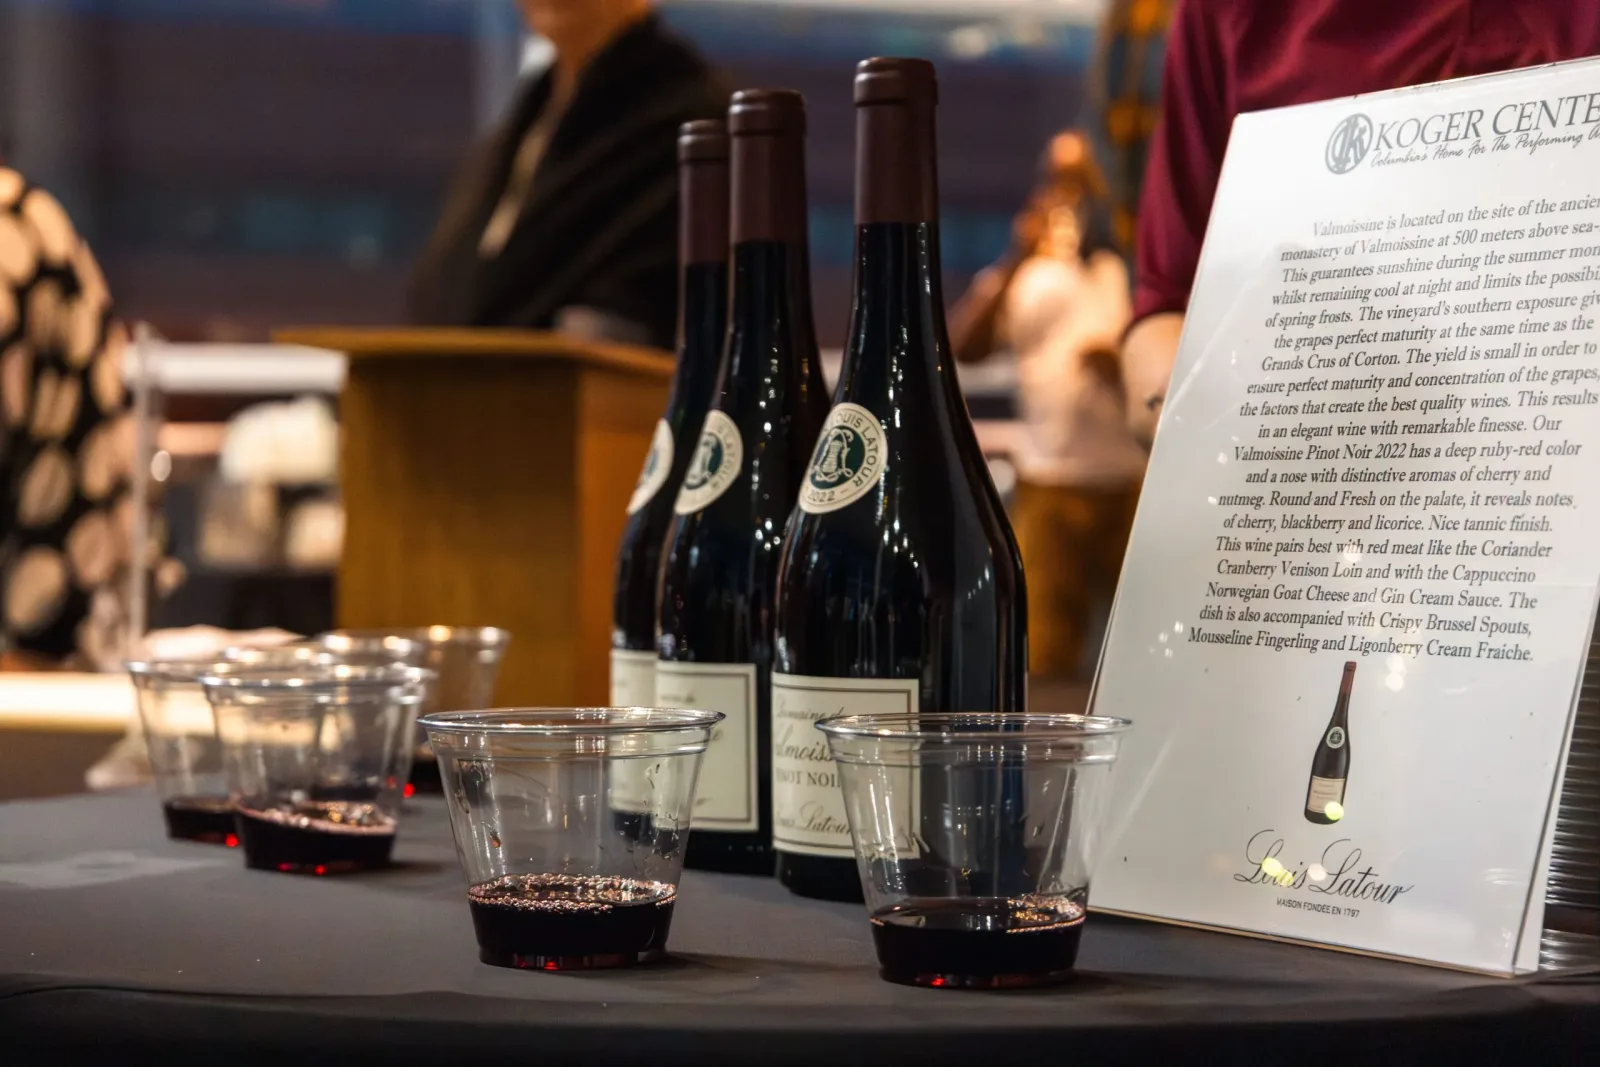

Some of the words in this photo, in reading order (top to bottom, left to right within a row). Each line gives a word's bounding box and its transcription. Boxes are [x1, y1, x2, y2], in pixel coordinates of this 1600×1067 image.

[1373, 108, 1484, 151] KOGER
[1371, 146, 1428, 168] Columbia's
[1433, 144, 1465, 160] Home
[1468, 140, 1486, 158] For
[1491, 136, 1510, 152] The
[1515, 132, 1583, 155] Performing
[1313, 220, 1383, 236] Valmoissine
[1399, 210, 1445, 228] located
[1492, 204, 1514, 218] site
[1280, 246, 1342, 261] monastery
[1360, 235, 1434, 253] Valmoissine
[1453, 229, 1478, 245] 500
[1480, 228, 1525, 243] meters
[1528, 222, 1568, 238] above
[1282, 268, 1308, 283] This
[1309, 266, 1374, 284] guarantees
[1377, 258, 1432, 274] sunshine
[1436, 254, 1481, 271] during
[1508, 248, 1566, 263] summer
[1272, 289, 1307, 305] whilst
[1309, 285, 1371, 302] remaining
[1374, 282, 1401, 297] cool
[1418, 277, 1451, 297] night
[1455, 275, 1481, 291] and
[1483, 273, 1522, 289] limits
[1279, 311, 1316, 330] spring
[1318, 309, 1353, 324] frosts.
[1359, 306, 1383, 321] The
[1453, 297, 1511, 315] southern
[1516, 295, 1578, 314] exposure
[1274, 334, 1292, 348] the
[1294, 335, 1333, 350] grapes
[1335, 329, 1379, 349] perfect
[1381, 325, 1437, 343] maturity
[1455, 322, 1477, 338] the
[1480, 323, 1514, 336] same
[1518, 319, 1550, 334] time
[1572, 315, 1594, 330] the
[1262, 355, 1304, 371] Grands
[1307, 354, 1336, 368] Crus
[1355, 351, 1400, 366] Corton.
[1406, 348, 1432, 364] The
[1433, 346, 1468, 366] yield
[1484, 342, 1521, 360] small
[1541, 341, 1579, 356] order
[1247, 383, 1285, 394] ensure
[1286, 377, 1329, 396] perfect
[1331, 374, 1385, 392] maturity
[1388, 372, 1413, 387] and
[1415, 369, 1505, 387] concentration
[1526, 367, 1548, 382] the
[1240, 402, 1258, 416] the
[1260, 401, 1299, 415] factors
[1302, 400, 1326, 414] that
[1328, 400, 1364, 413] create
[1368, 398, 1388, 412] the
[1391, 397, 1417, 411] best
[1420, 394, 1466, 414] quality
[1470, 394, 1511, 408] wines.
[1518, 390, 1548, 407] This
[1552, 389, 1599, 405] results
[1291, 423, 1333, 441] elegant
[1337, 422, 1366, 436] wine
[1370, 420, 1398, 435] with
[1401, 417, 1475, 434] remarkable
[1478, 416, 1527, 433] finesse.
[1532, 414, 1562, 431] Our
[833, 412, 863, 429] OUIS
[852, 426, 878, 488] LATOUR
[1234, 446, 1303, 461] Valmoissine
[1306, 444, 1340, 460] Pinot
[1343, 444, 1372, 459] Noir
[1375, 443, 1407, 459] 2022
[1409, 443, 1430, 458] has
[1445, 442, 1477, 461] deep
[1480, 440, 1543, 460] ruby-red
[1545, 440, 1582, 456] color
[1246, 468, 1269, 483] and
[1280, 472, 1307, 482] nose
[1311, 468, 1337, 482] with
[1341, 467, 1406, 482] distinctive
[1409, 469, 1456, 482] aromas
[1476, 466, 1520, 485] cherry
[1524, 465, 1552, 481] and
[1218, 494, 1265, 510] nutmeg.
[1269, 491, 1312, 506] Round
[1314, 492, 1338, 506] and
[1340, 491, 1376, 506] Fresh
[1400, 491, 1421, 506] the
[1423, 491, 1466, 510] palate,
[1484, 490, 1532, 506] reveals
[1238, 514, 1277, 532] cherry,
[1281, 514, 1345, 533] blackberry
[1348, 515, 1372, 530] and
[1374, 514, 1424, 530] licorice.
[1428, 515, 1460, 531] Nice
[1464, 517, 1507, 531] tannic
[1508, 515, 1552, 532] finish.
[1216, 536, 1241, 551] This
[1245, 538, 1272, 551] wine
[1273, 538, 1305, 556] pairs
[1308, 538, 1332, 553] best
[1336, 539, 1364, 553] with
[1367, 539, 1389, 554] red
[1391, 542, 1424, 555] meat
[1427, 539, 1452, 555] like
[1456, 540, 1477, 555] the
[1481, 540, 1553, 557] Coriander
[1217, 559, 1277, 579] Cranberry
[1281, 561, 1329, 577] Venison
[1332, 562, 1362, 578] Loin
[1366, 564, 1391, 579] and
[1394, 564, 1423, 580] with
[1427, 564, 1449, 580] the
[1452, 564, 1536, 586] Cappuccino
[1205, 582, 1269, 602] Norwegian
[1273, 584, 1304, 600] Goat
[1306, 585, 1350, 602] Cheese
[1352, 588, 1377, 603] and
[1381, 587, 1405, 604] Gin
[1410, 588, 1454, 606] Cream
[1458, 590, 1502, 607] Sauce.
[1508, 591, 1538, 609] The
[1199, 605, 1223, 620] dish
[1238, 607, 1260, 621] also
[1263, 610, 1344, 628] accompanied
[1348, 612, 1376, 627] with
[1380, 612, 1423, 633] Crispy
[1425, 614, 1477, 632] Brussel
[1479, 616, 1532, 637] Spouts,
[1188, 627, 1253, 646] Mousseline
[1255, 630, 1320, 653] Fingerling
[1322, 635, 1346, 651] and
[1349, 635, 1423, 658] Ligonberry
[1427, 639, 1472, 657] Cream
[1476, 642, 1533, 661] Fraiche.
[1308, 838, 1415, 904] Latour
[1277, 898, 1302, 909] MAISON
[1332, 907, 1341, 915] EN
[1343, 908, 1359, 917] 1797
